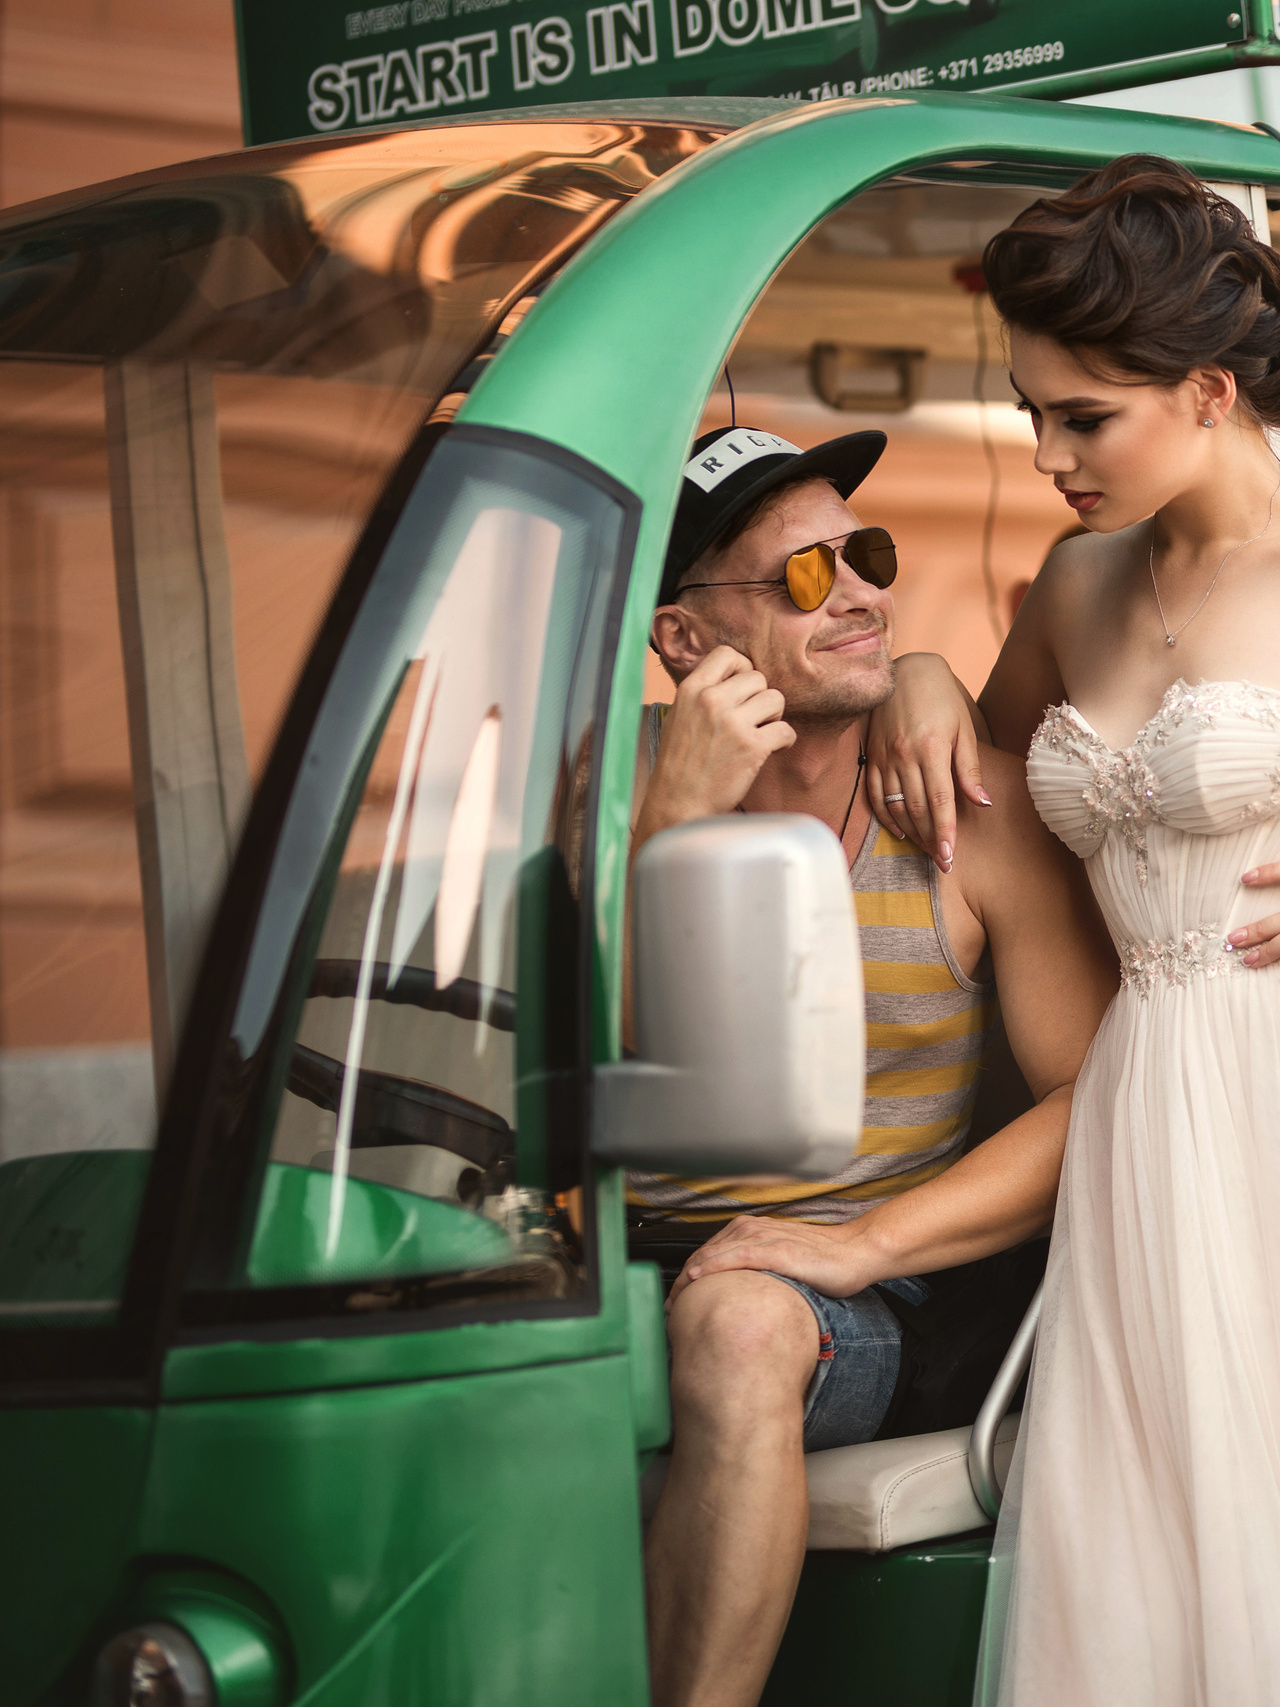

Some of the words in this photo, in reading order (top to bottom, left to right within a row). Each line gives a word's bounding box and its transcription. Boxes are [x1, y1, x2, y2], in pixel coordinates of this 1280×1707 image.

[345, 1, 408, 39] EVERY
[411, 0, 449, 25] DAY
[308, 30, 497, 131] START
[510, 16, 574, 90] IS
[587, 0, 657, 75] IN
[938, 57, 978, 81] +371
[982, 41, 1064, 74] 29356999
